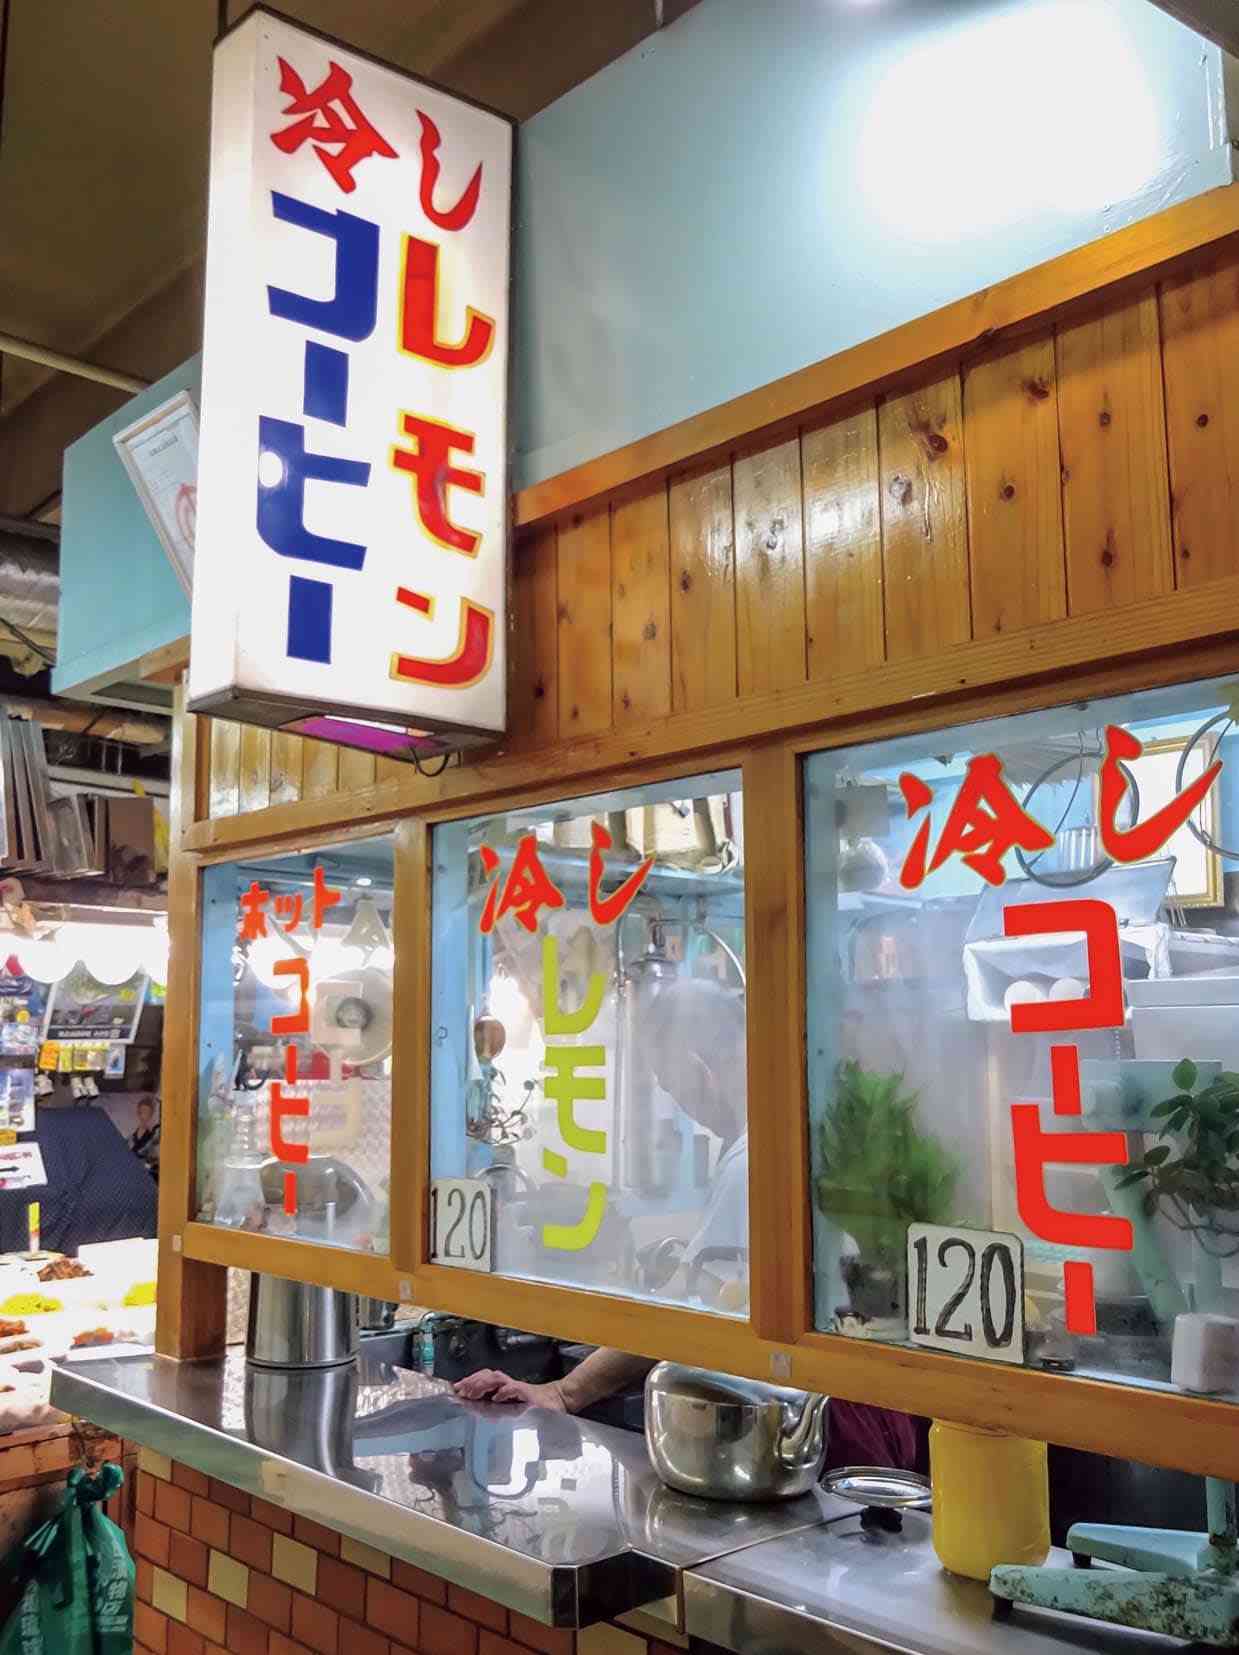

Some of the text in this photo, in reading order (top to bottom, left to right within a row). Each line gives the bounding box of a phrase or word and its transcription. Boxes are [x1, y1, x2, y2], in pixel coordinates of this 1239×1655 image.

[270, 56, 482, 231] 冷し
[256, 190, 379, 664] コーヒー
[389, 233, 495, 689] レモン
[480, 820, 654, 933] 冷し
[900, 725, 1222, 888] 冷し
[241, 866, 340, 940] ホット
[270, 958, 309, 1215] コーヒー
[543, 935, 606, 1249] レモン
[1003, 898, 1133, 1335] コーヒー
[431, 1187, 487, 1259] 120
[913, 1235, 1015, 1347] 120
